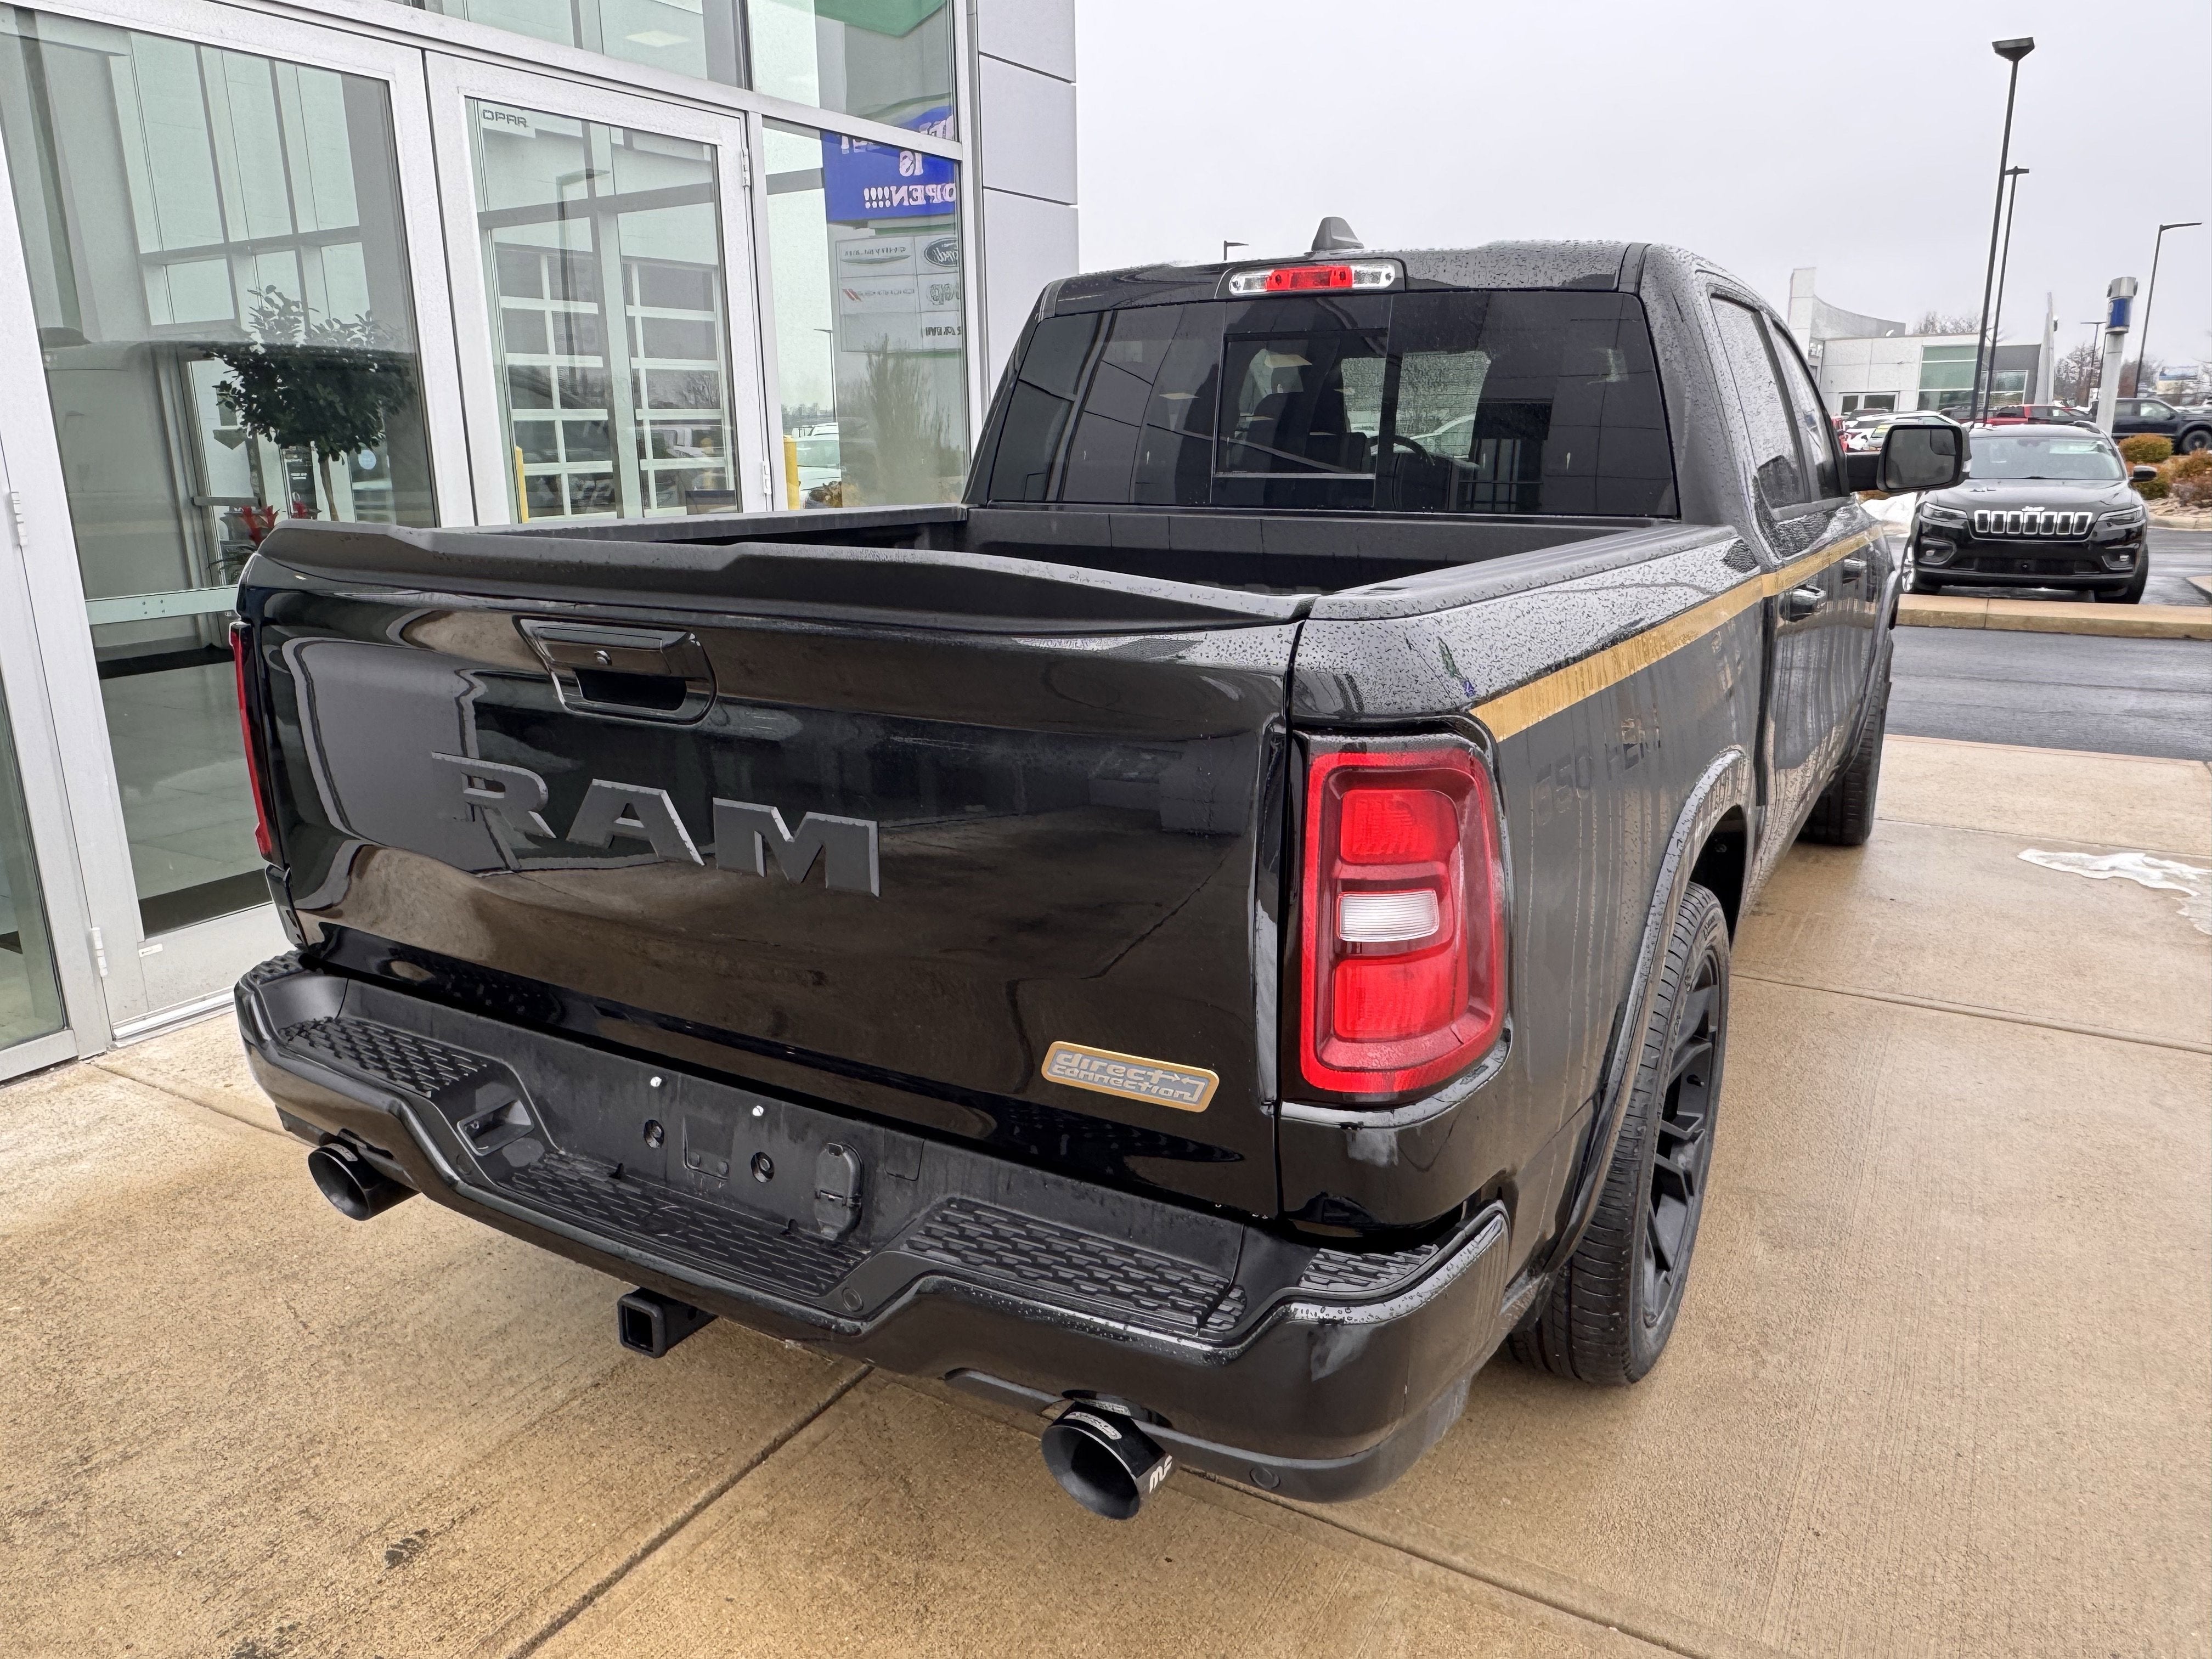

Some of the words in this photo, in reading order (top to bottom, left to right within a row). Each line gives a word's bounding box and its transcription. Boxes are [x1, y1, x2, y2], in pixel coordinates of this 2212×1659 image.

[431, 751, 879, 898] RAM
[1052, 1064, 1191, 1101] connection
[1056, 1053, 1164, 1085] direct
